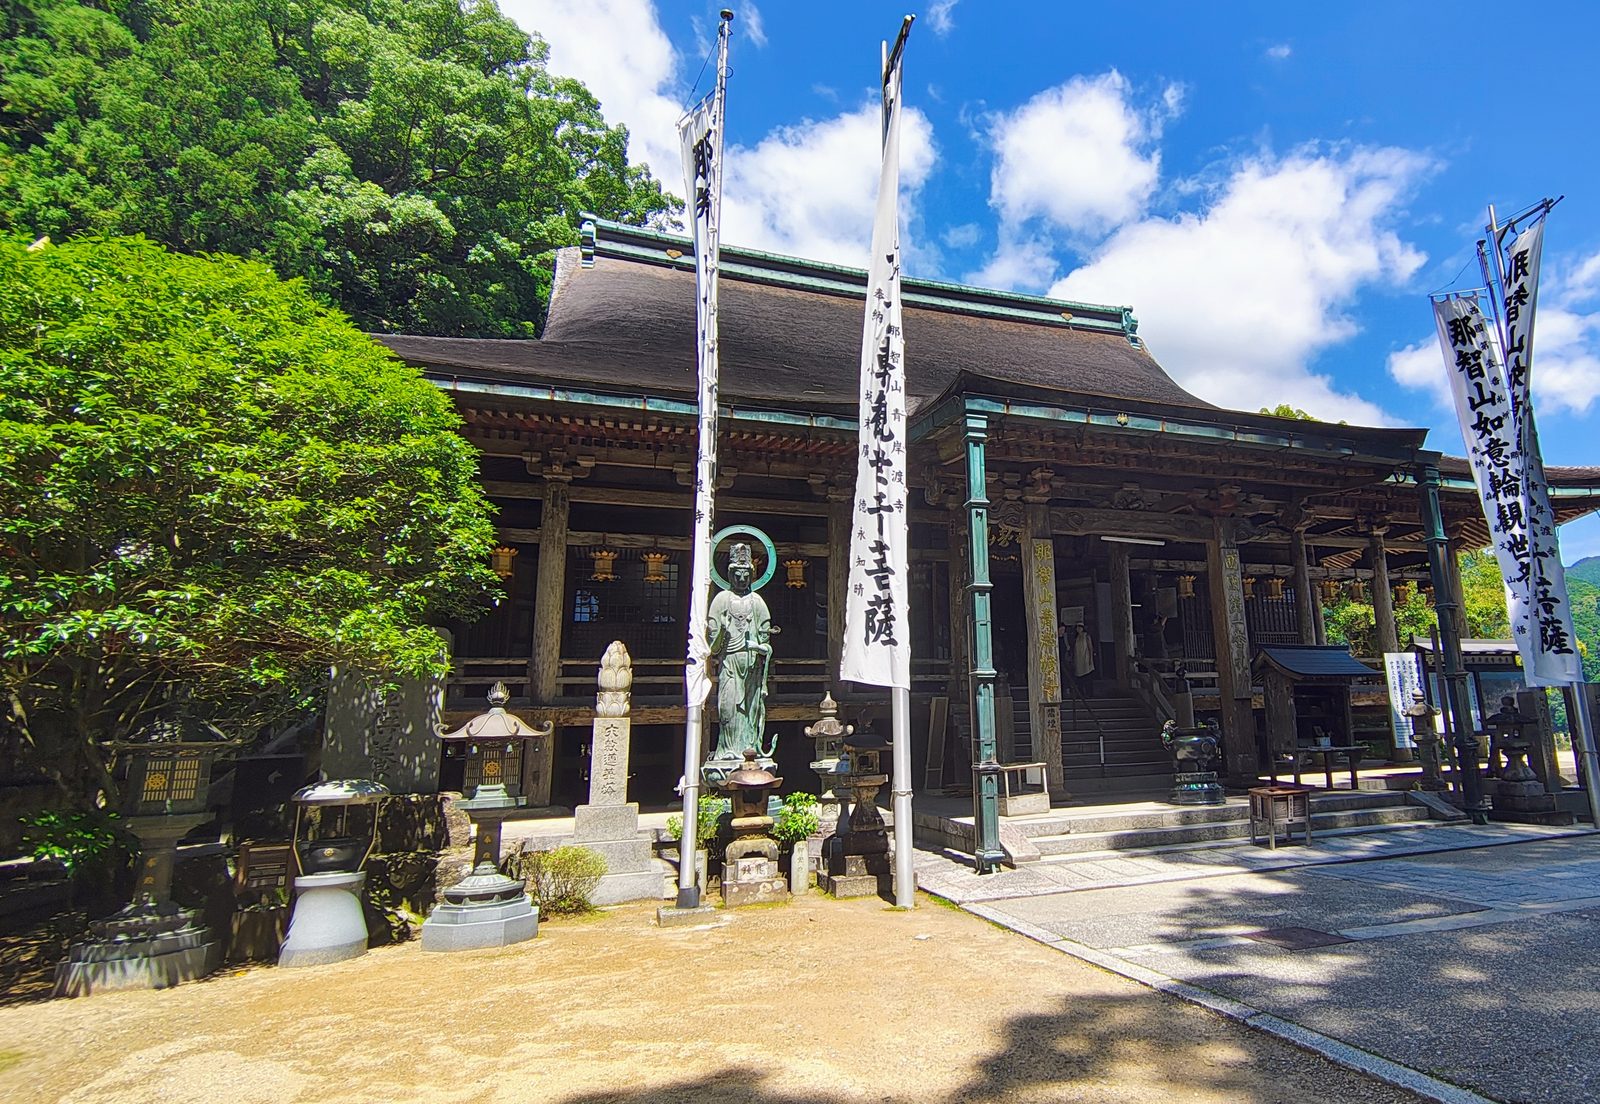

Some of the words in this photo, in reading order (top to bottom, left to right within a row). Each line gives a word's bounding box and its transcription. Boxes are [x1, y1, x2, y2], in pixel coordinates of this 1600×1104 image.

[872, 287, 885, 324] 奉納
[889, 325, 904, 513] 那智山青岸渡寺
